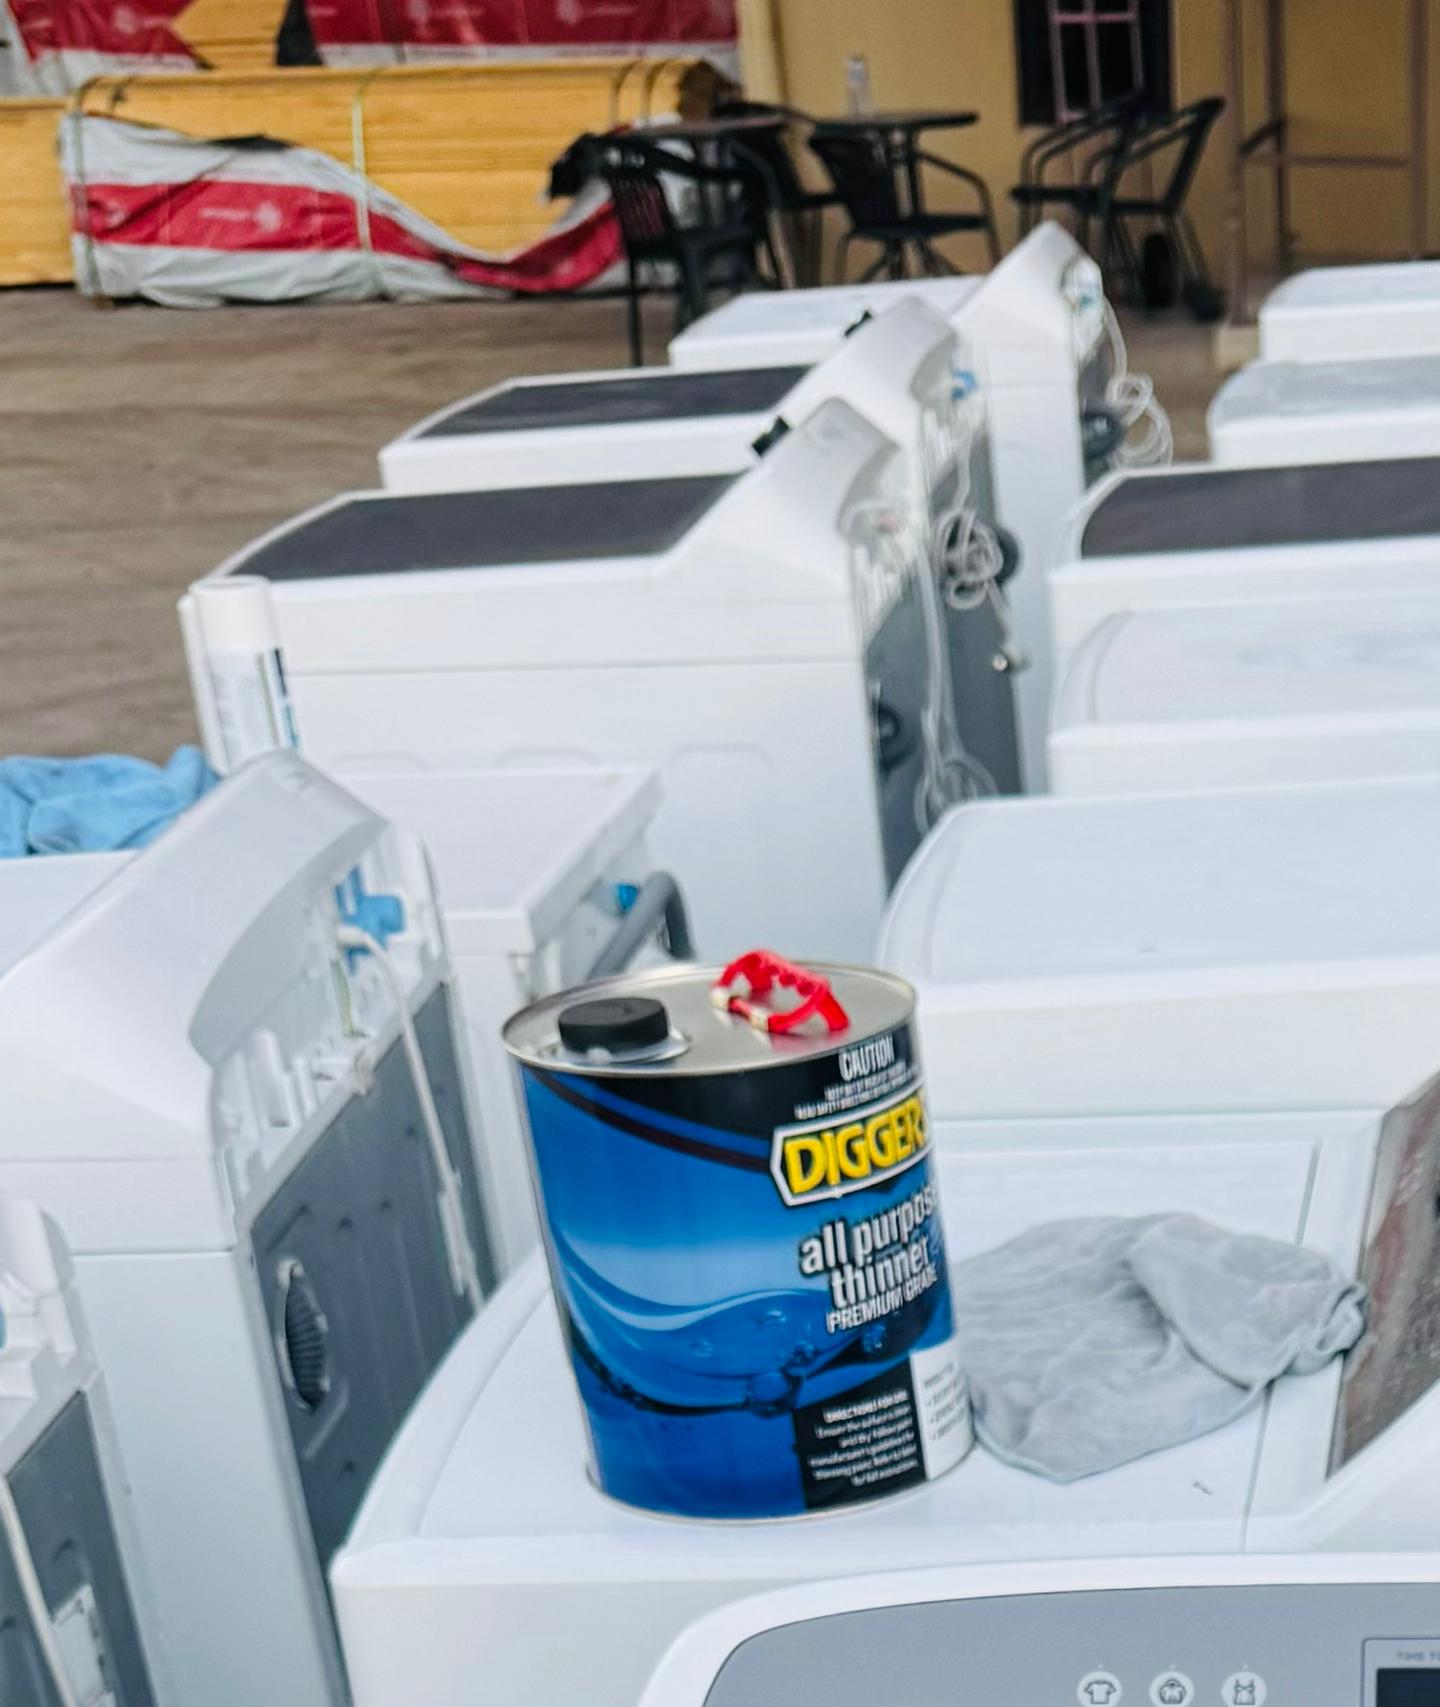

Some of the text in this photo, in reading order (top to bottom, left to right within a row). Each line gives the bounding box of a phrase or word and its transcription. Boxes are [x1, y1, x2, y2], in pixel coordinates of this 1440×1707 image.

[839, 1034, 896, 1081] CAUTION
[783, 1088, 925, 1194] DIGGER
[802, 1220, 848, 1275] all
[832, 1236, 929, 1309] thinner
[826, 1287, 904, 1334] PREMIUM
[1398, 1652, 1425, 1662] TIME
